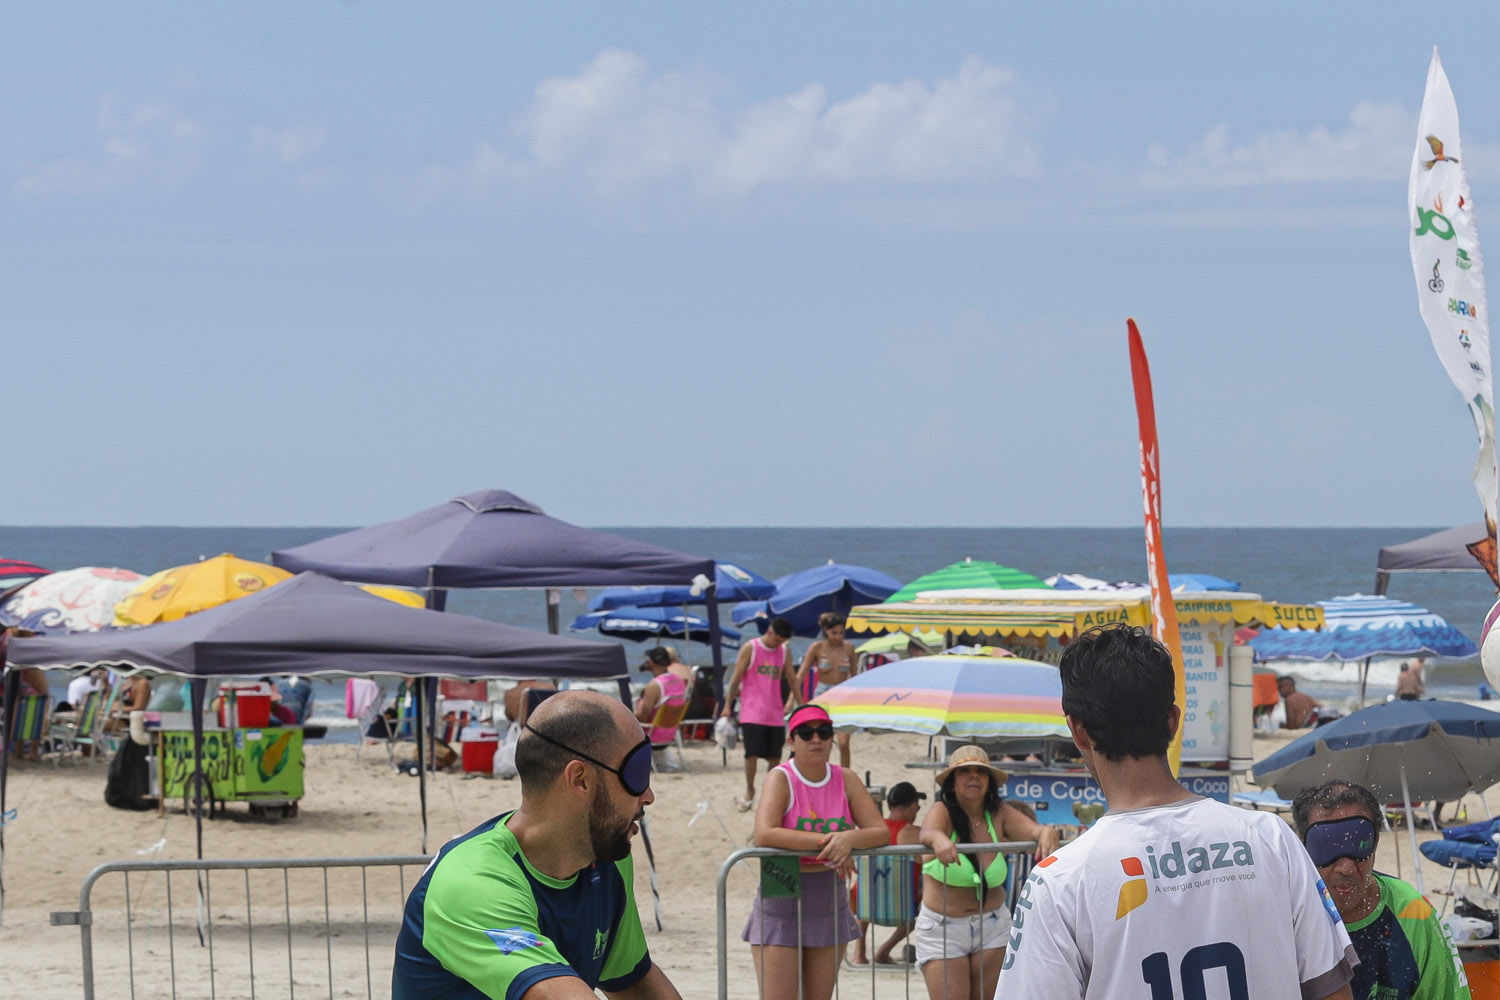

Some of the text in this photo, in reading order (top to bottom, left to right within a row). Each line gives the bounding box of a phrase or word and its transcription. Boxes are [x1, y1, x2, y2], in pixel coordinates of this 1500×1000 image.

[1274, 606, 1317, 621] SUCO
[1015, 780, 1043, 797] de
[1192, 778, 1228, 794] Coco
[1146, 840, 1255, 880] idaza
[1154, 885, 1161, 894] A
[1193, 876, 1212, 889] que
